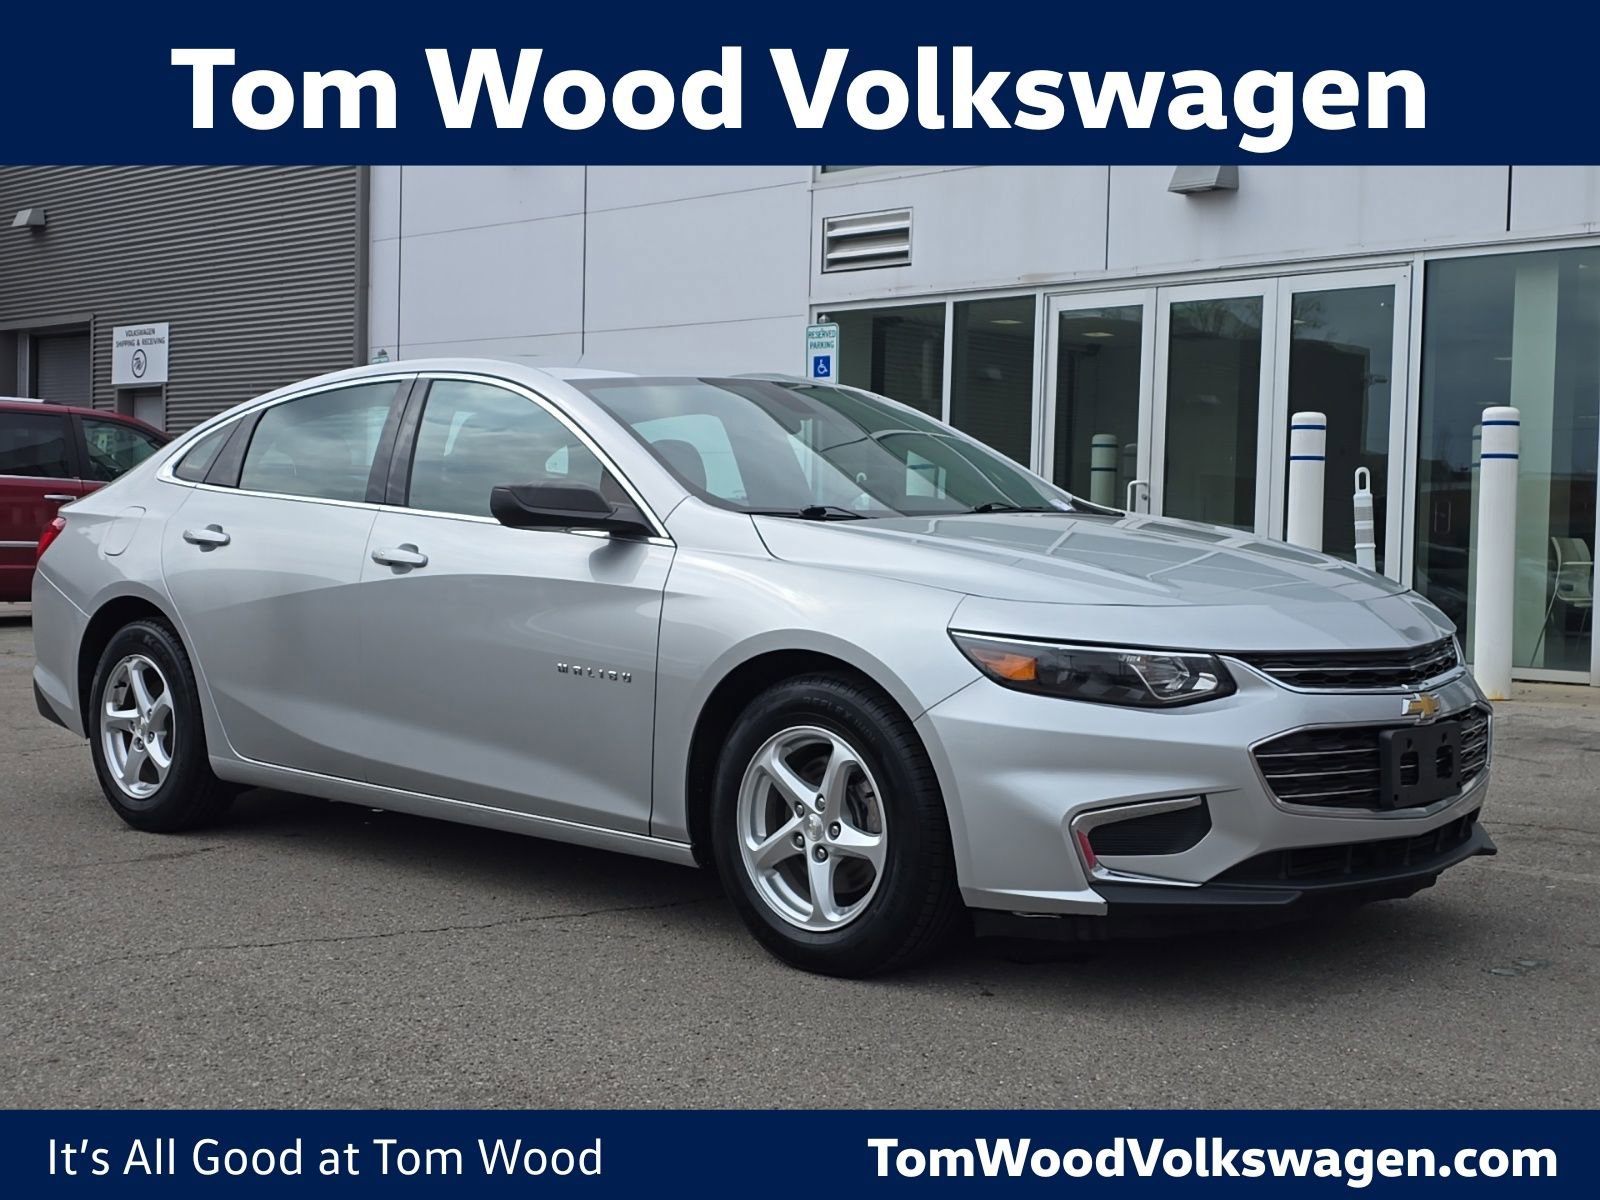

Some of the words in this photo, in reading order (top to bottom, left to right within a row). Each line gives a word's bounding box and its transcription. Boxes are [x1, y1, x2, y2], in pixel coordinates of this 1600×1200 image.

[125, 328, 155, 337] VOLKSWAGEN
[808, 330, 836, 338] RESERVED
[116, 339, 135, 348] SHIPPING
[142, 337, 165, 346] RECEIVING
[810, 341, 834, 349] PARKING
[557, 662, 632, 683] MALIBU
